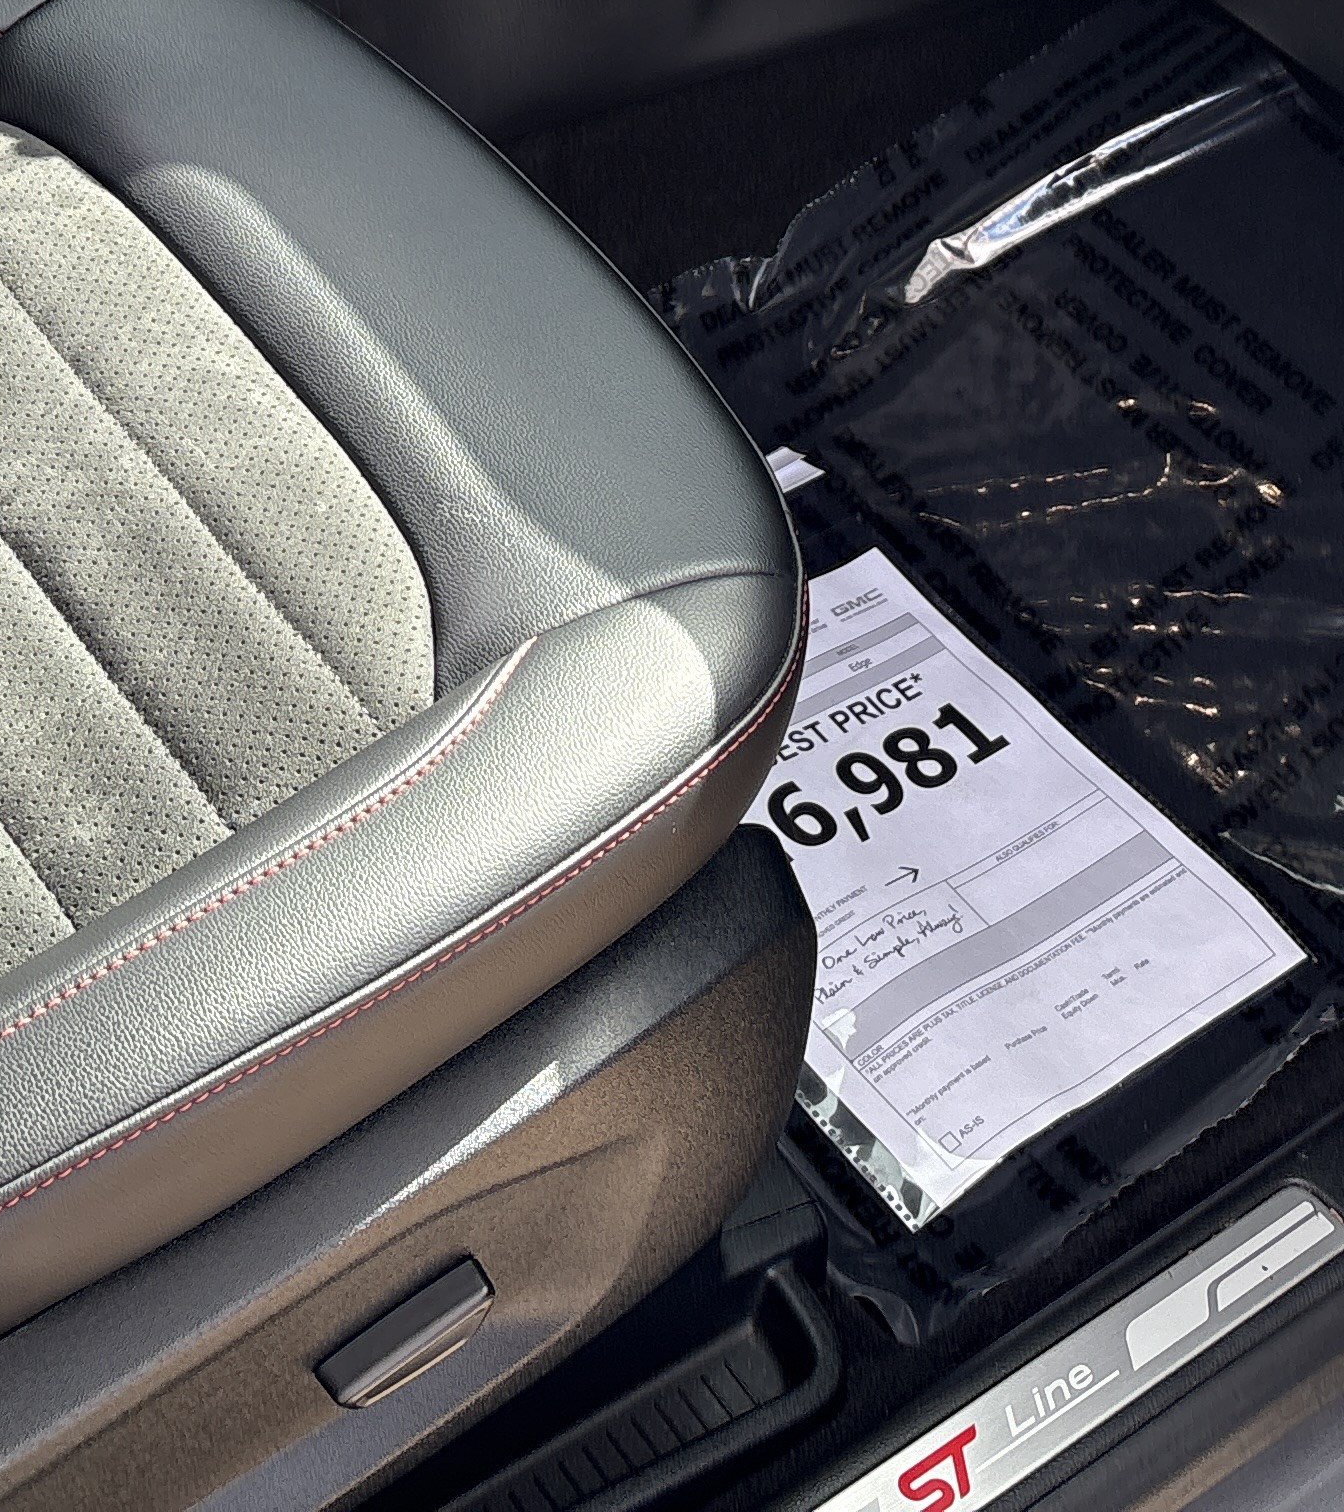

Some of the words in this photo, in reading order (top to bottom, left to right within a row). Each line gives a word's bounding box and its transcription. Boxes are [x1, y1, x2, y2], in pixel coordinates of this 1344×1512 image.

[831, 587, 883, 617] GMC
[849, 657, 872, 672] Edge
[775, 721, 828, 764] EST
[766, 702, 1012, 848] 6,981
[858, 1044, 884, 1067] COLOR
[881, 1039, 909, 1063] PRICES
[909, 1029, 924, 1045] ARE
[922, 1016, 943, 1034] PLUS
[959, 1114, 985, 1140] AS-IS
[896, 1424, 978, 1512] ST
[1004, 1359, 1096, 1439] Line
